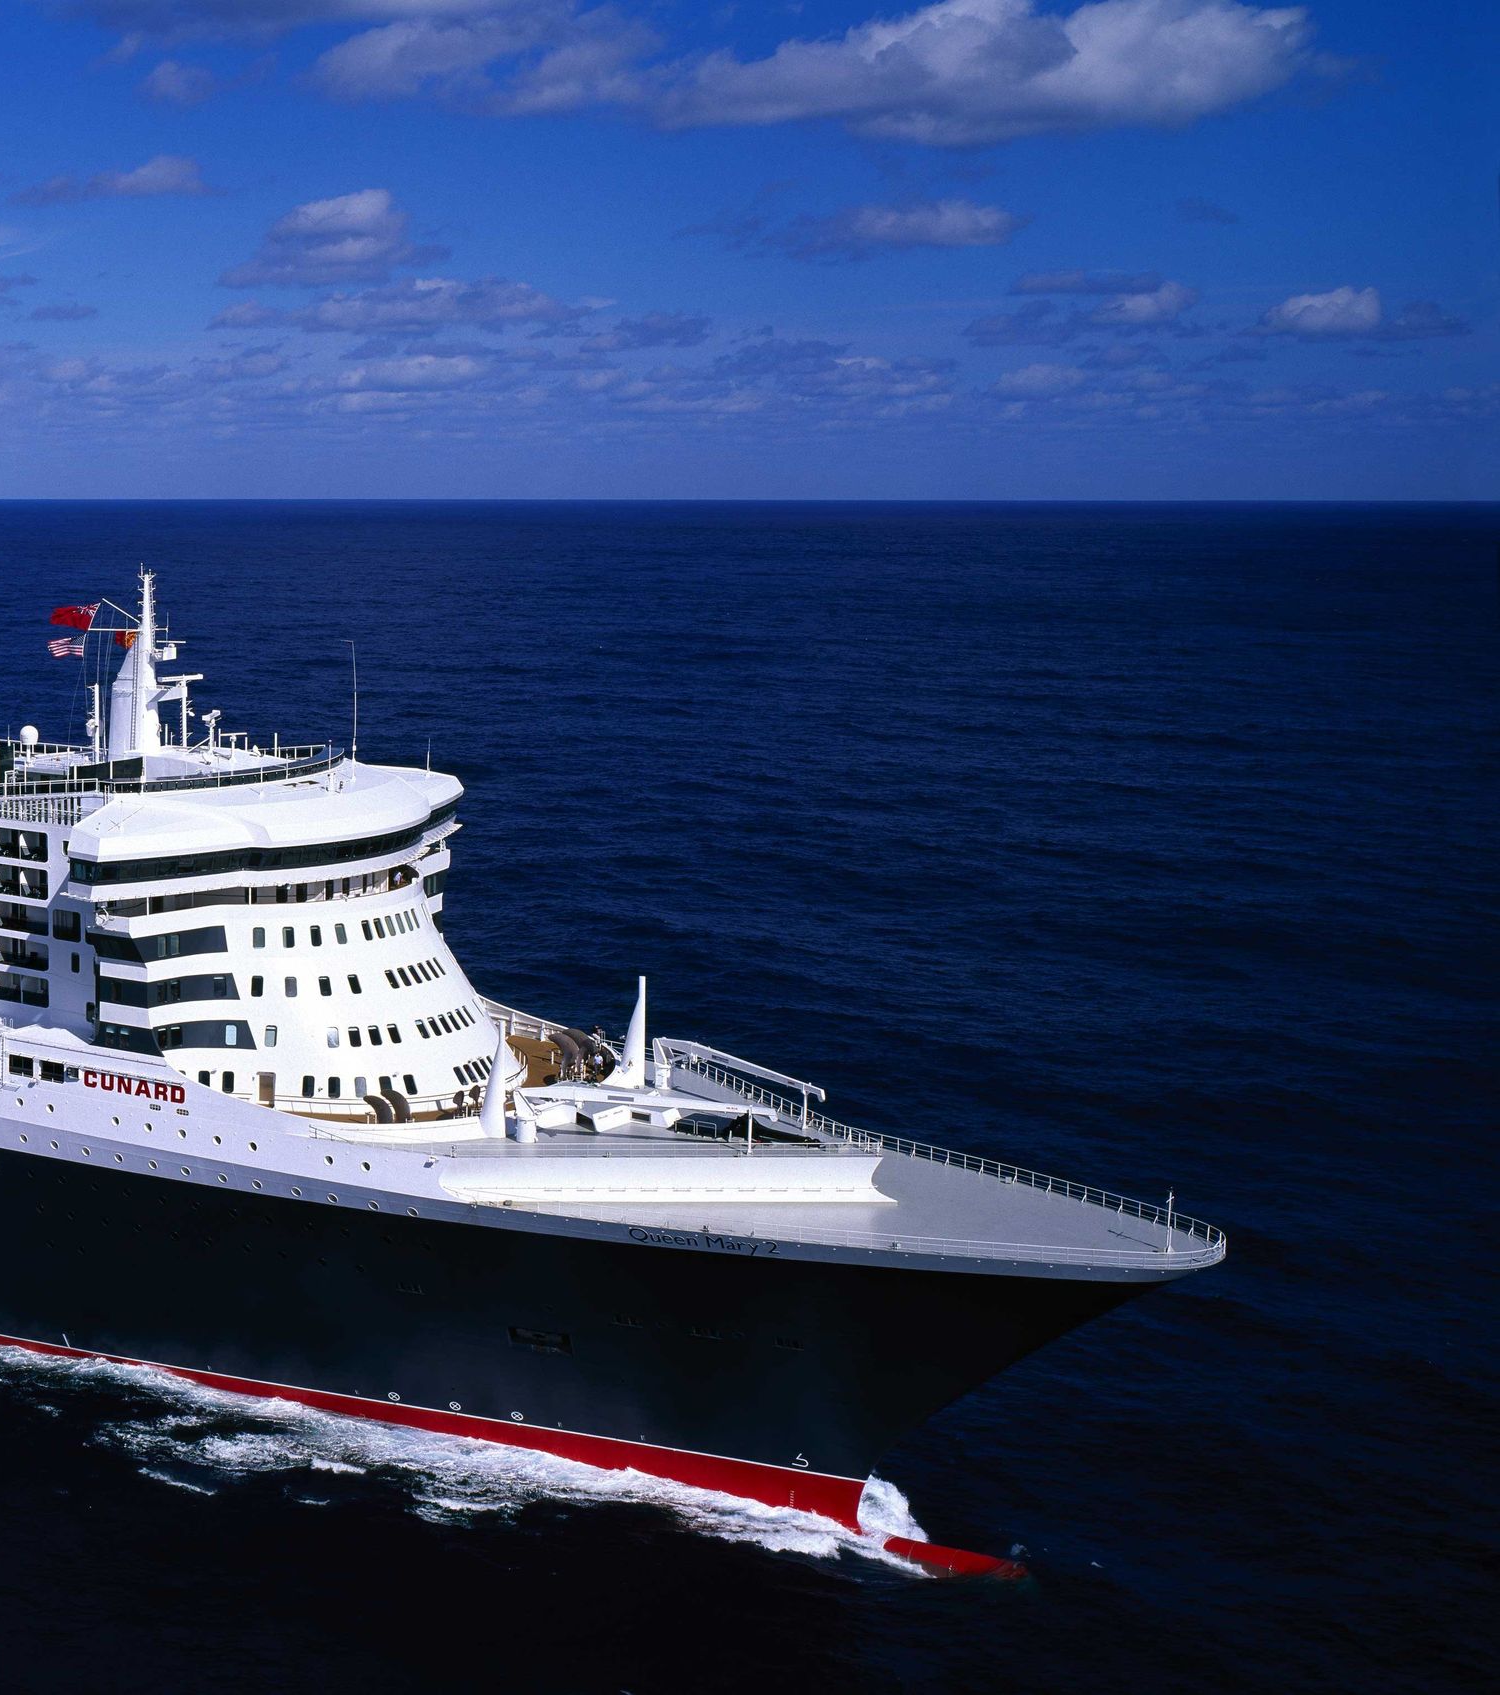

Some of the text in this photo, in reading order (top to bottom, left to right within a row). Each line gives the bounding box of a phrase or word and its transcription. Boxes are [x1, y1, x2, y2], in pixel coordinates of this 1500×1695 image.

[83, 1070, 186, 1104] CUNARD
[628, 1227, 780, 1256] Queen Mary 2
